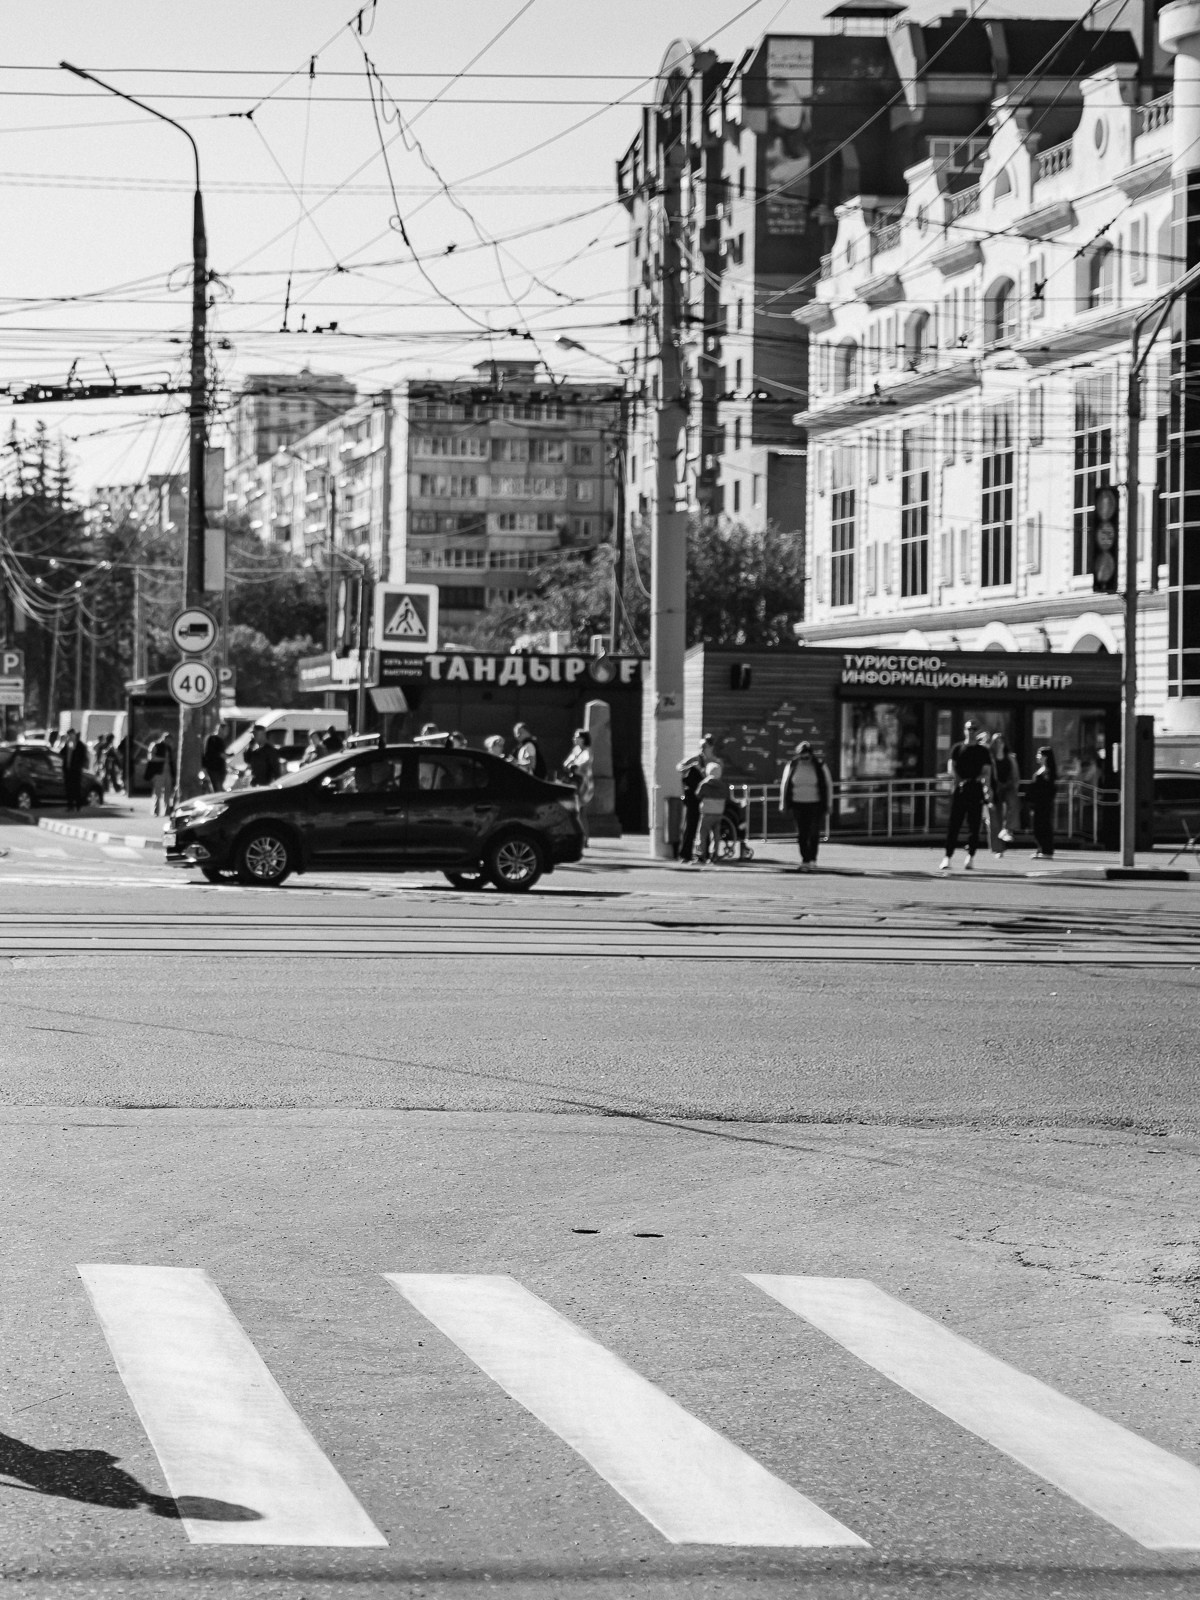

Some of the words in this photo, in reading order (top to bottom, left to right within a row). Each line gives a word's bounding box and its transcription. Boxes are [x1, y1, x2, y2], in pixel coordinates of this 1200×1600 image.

[3, 653, 19, 674] P
[424, 655, 585, 686] ТАНДЫР
[179, 675, 206, 693] 40
[841, 670, 1009, 689] ИНФОРМАЦИОННЫЙ
[1016, 674, 1073, 692] ЦЕНТР
